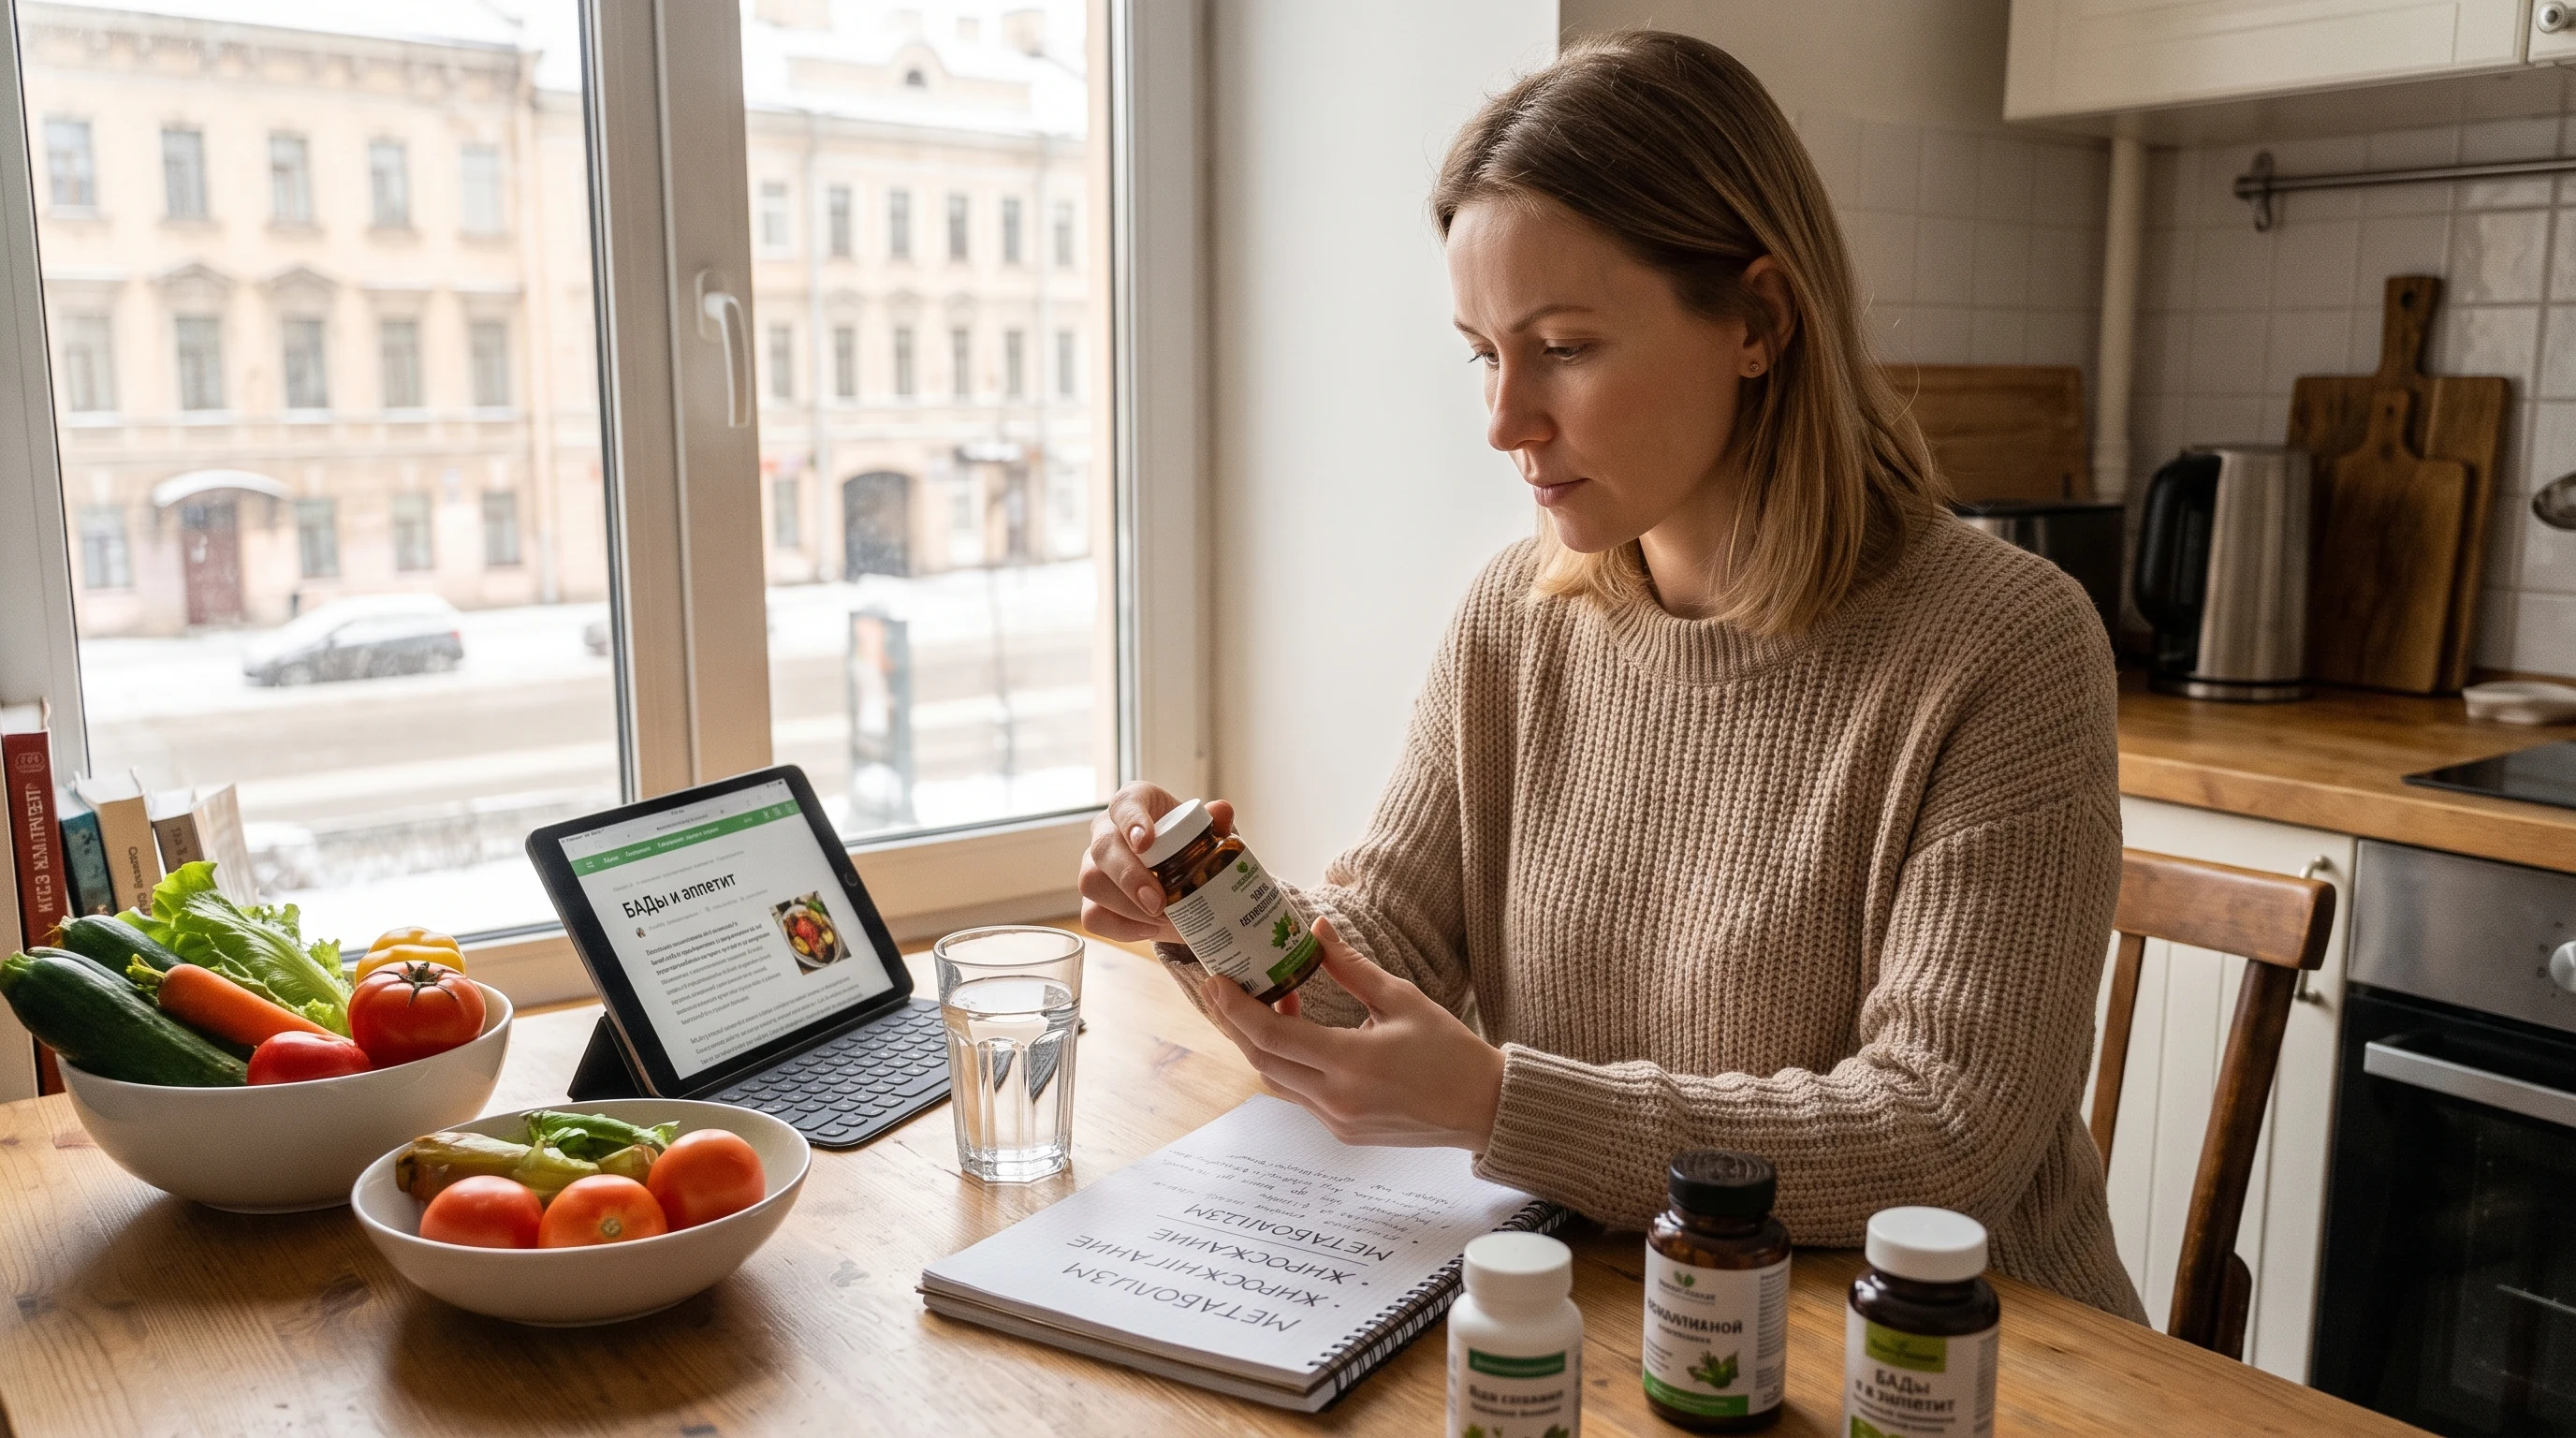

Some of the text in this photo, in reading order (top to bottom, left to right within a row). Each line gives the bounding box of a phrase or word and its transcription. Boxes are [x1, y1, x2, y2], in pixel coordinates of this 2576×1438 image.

[622, 892, 669, 919] БАДы
[670, 892, 681, 904] и
[683, 873, 737, 901] аппетит
